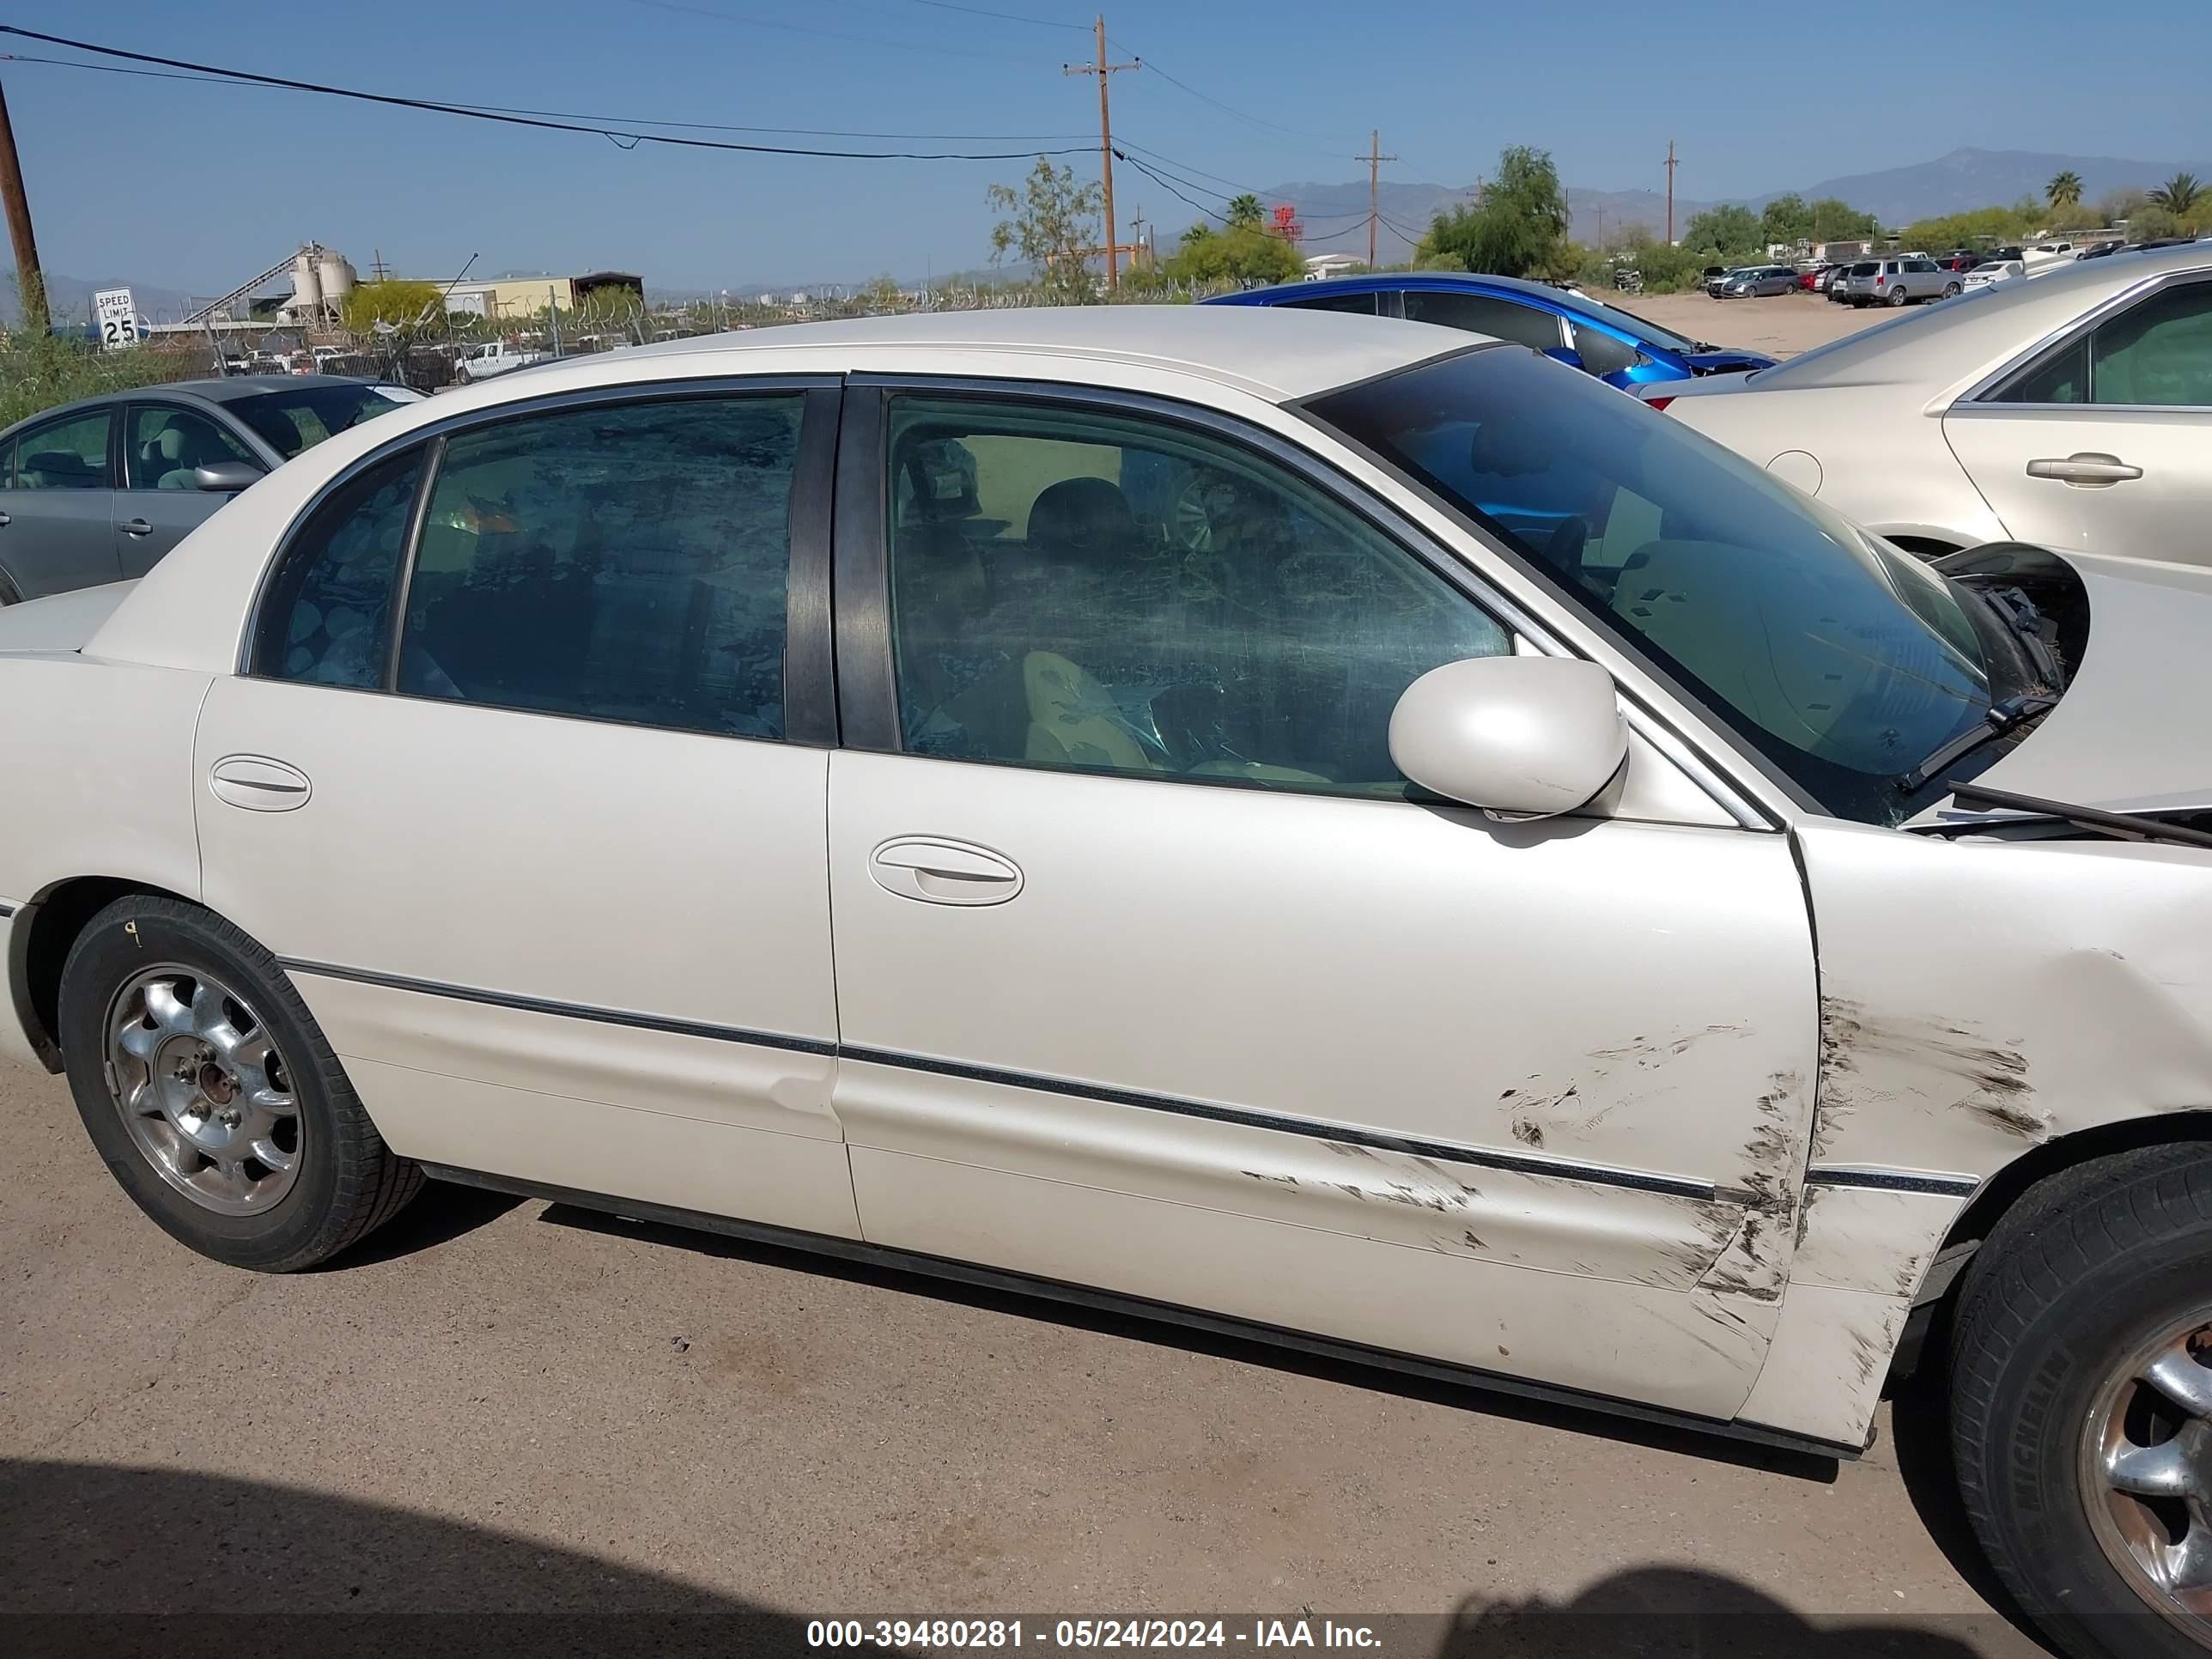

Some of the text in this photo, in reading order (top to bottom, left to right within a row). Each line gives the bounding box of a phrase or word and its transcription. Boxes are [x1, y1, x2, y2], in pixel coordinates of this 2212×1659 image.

[99, 295, 130, 307] SPEED
[103, 307, 128, 319] LIMIT
[104, 319, 135, 343] 25
[2013, 1346, 2072, 1513] MICHELIN
